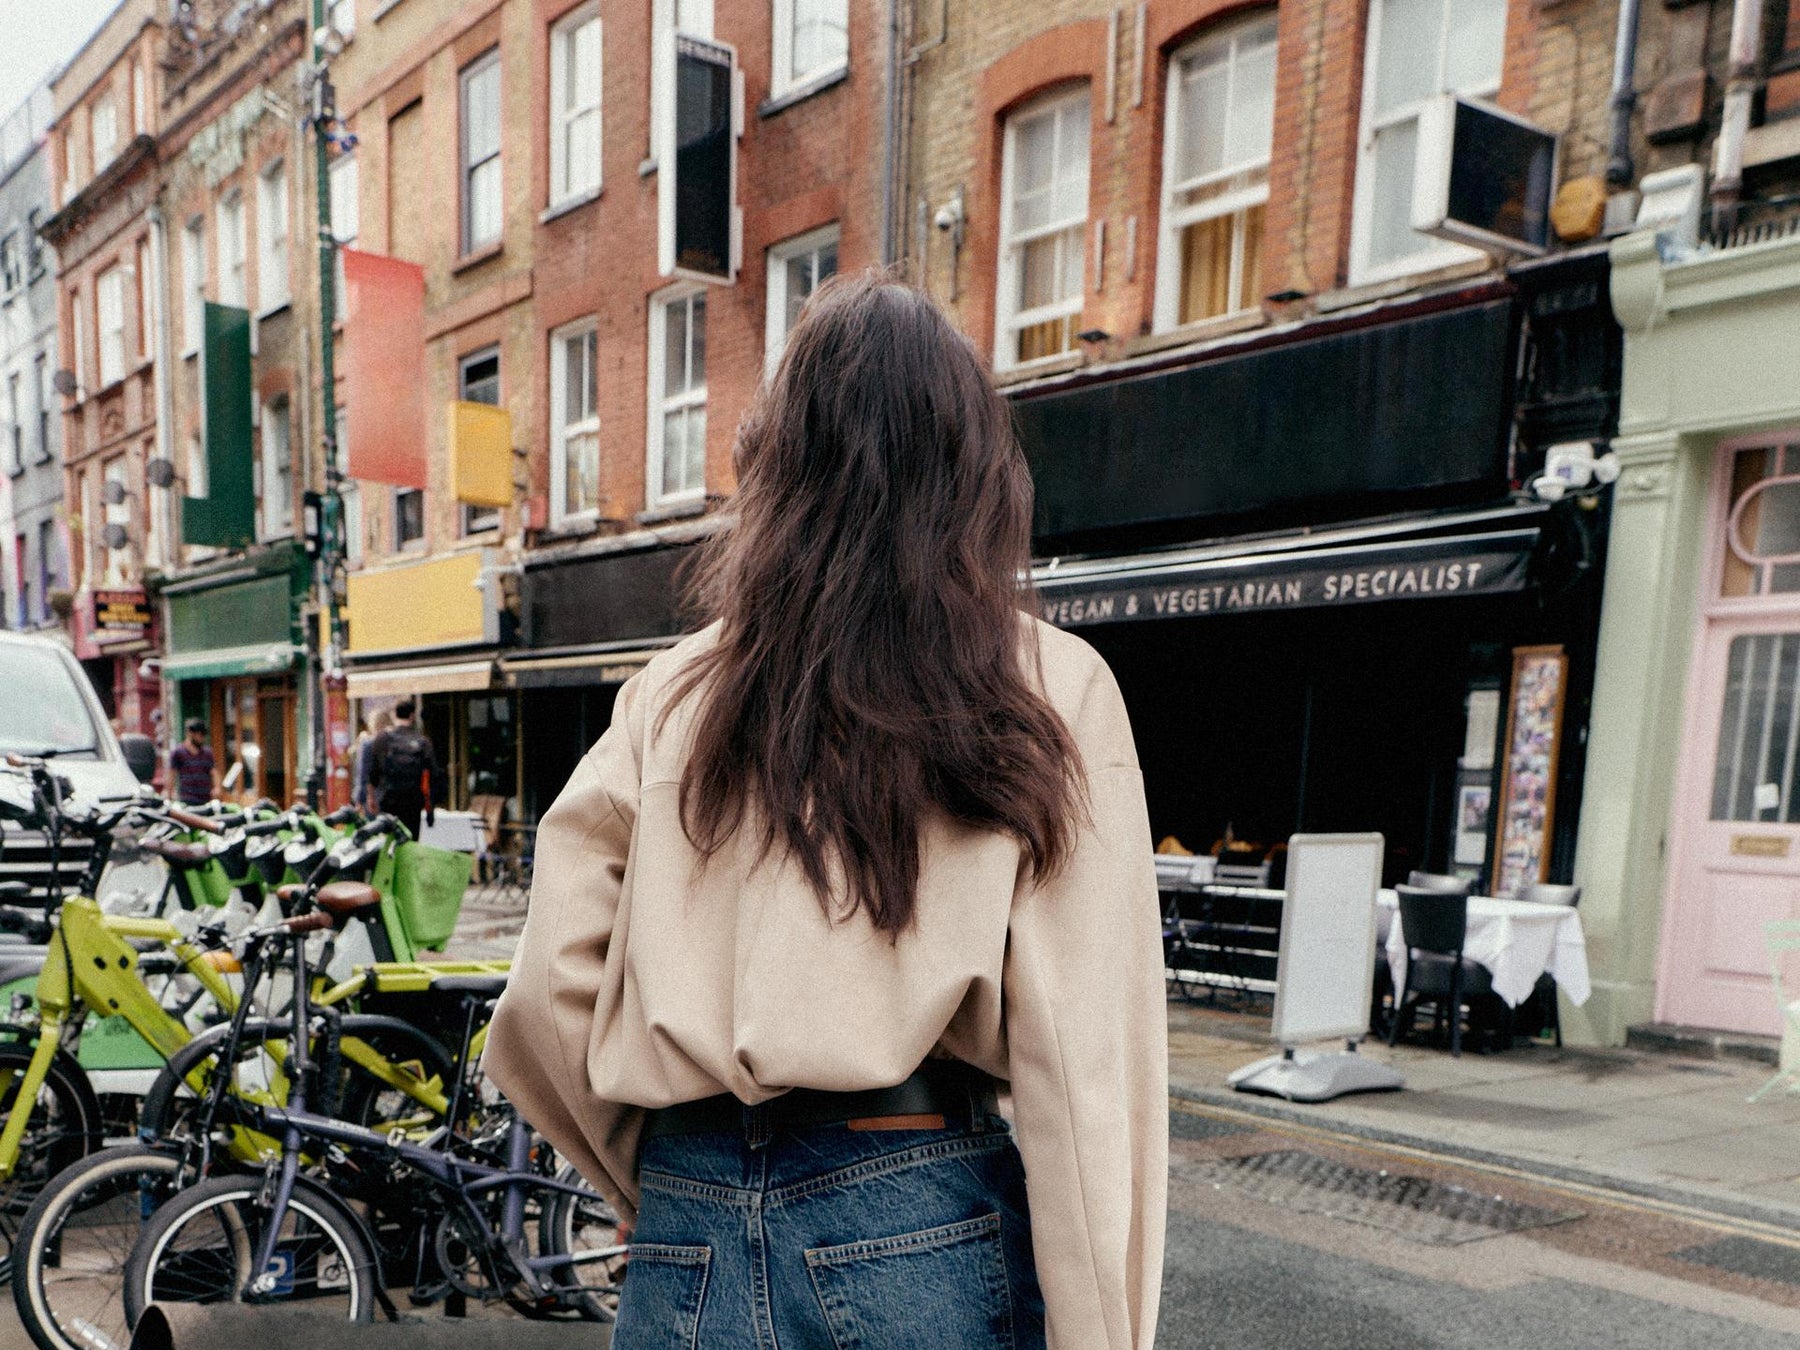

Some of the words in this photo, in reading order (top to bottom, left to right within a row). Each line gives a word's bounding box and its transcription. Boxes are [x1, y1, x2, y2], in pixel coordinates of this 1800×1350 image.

[1044, 597, 1115, 622] VEGAN
[1125, 593, 1138, 616] &
[1152, 580, 1302, 614] VEGETARIAN
[1323, 562, 1482, 600] SPECIALIST
